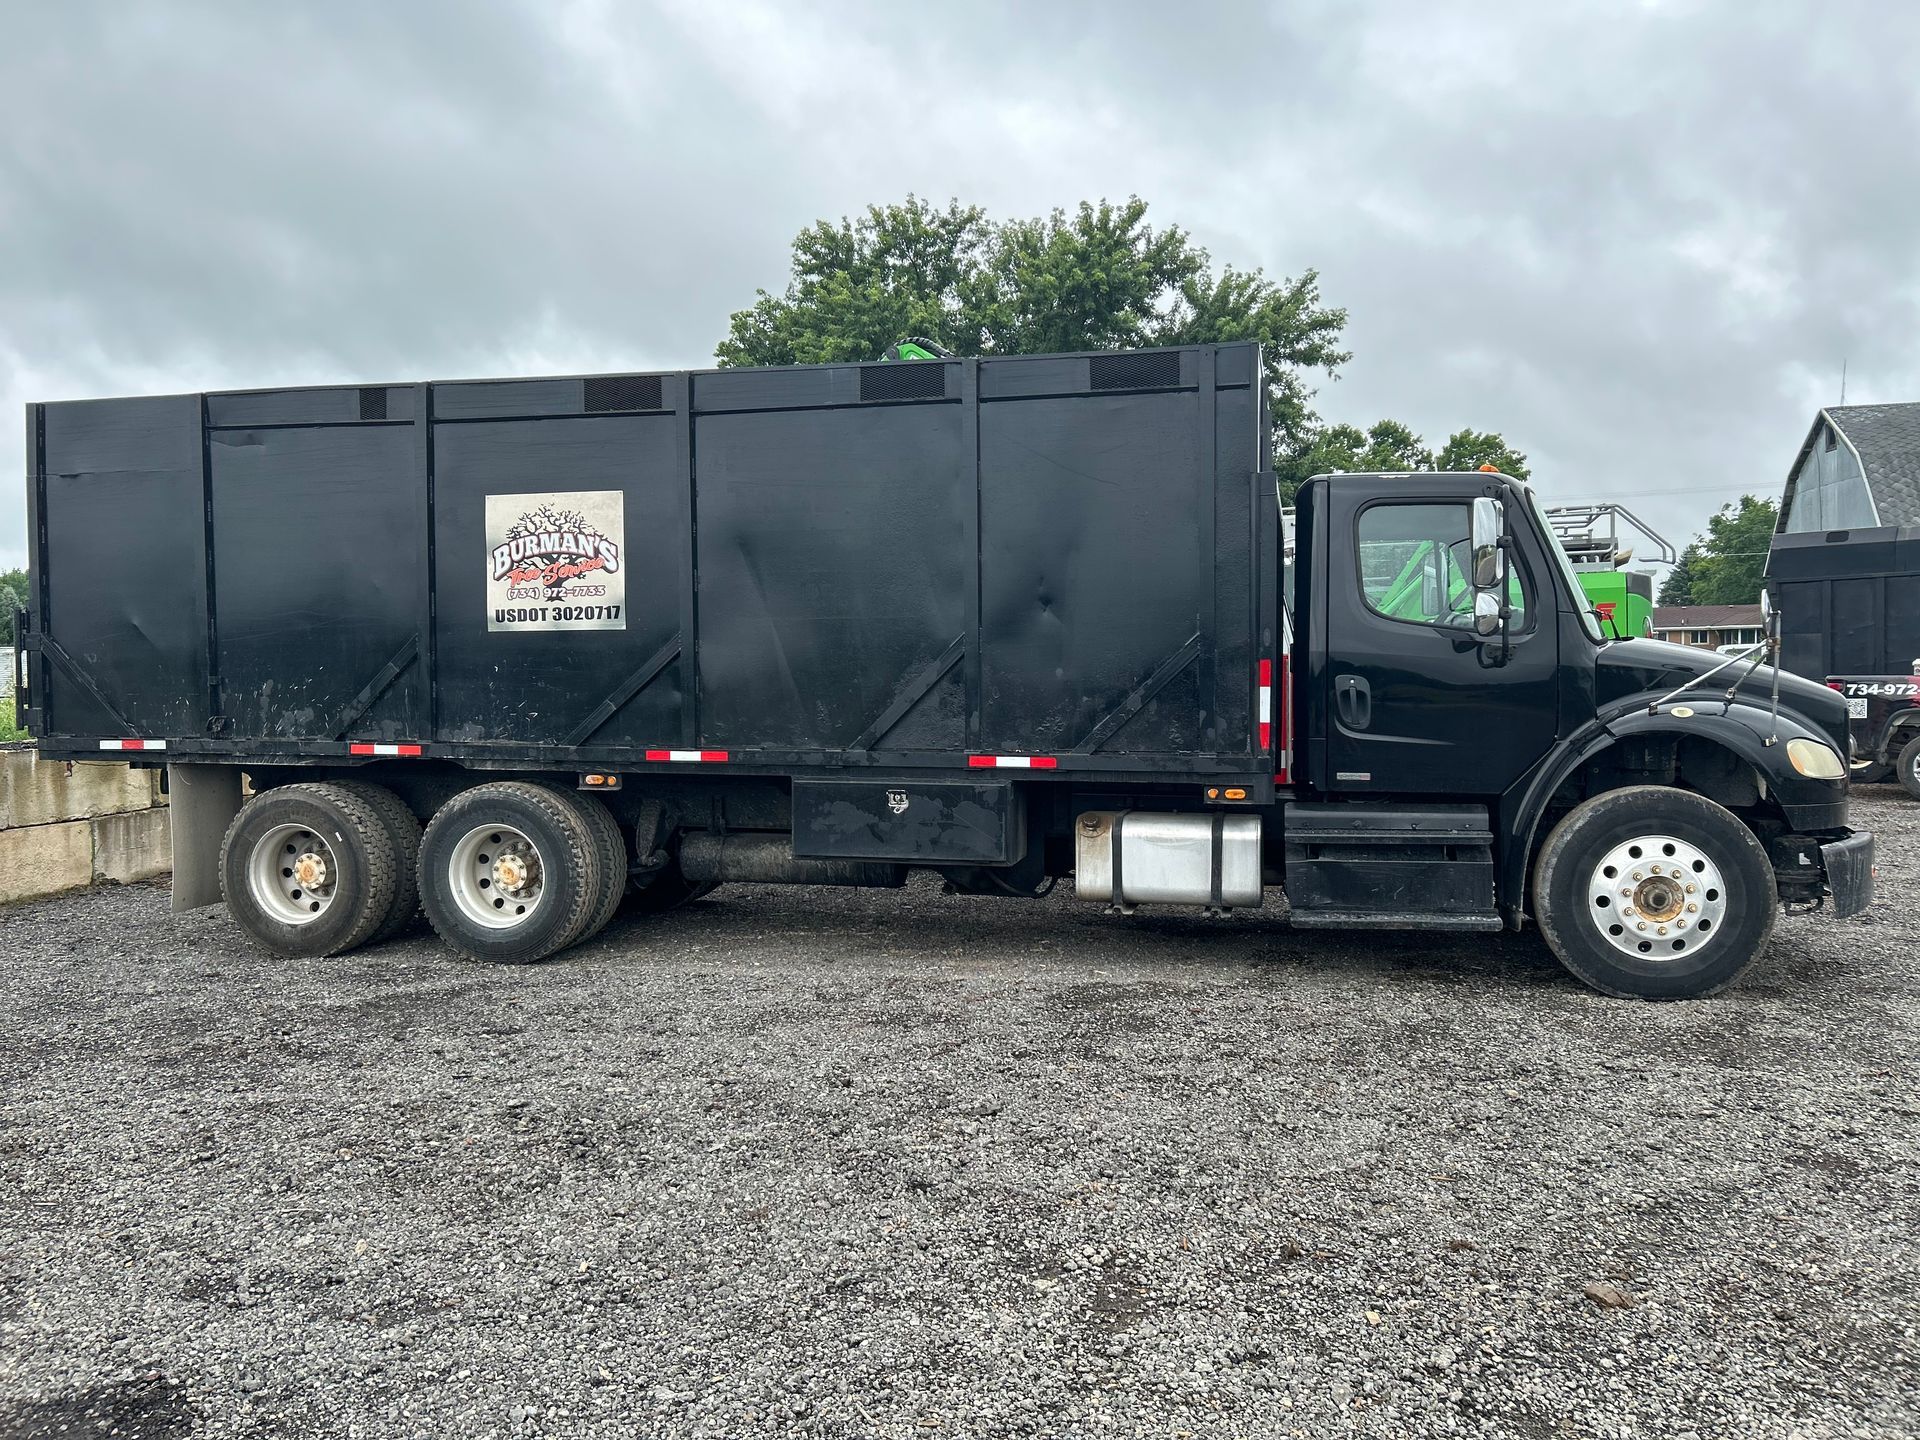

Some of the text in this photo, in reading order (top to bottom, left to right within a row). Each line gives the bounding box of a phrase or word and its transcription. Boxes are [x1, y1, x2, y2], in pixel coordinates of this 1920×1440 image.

[492, 531, 619, 581] BURMAN'S
[507, 556, 605, 588] Tree Service
[507, 585, 606, 600] (734) 972-7733
[495, 605, 621, 623] USDOT 3020717
